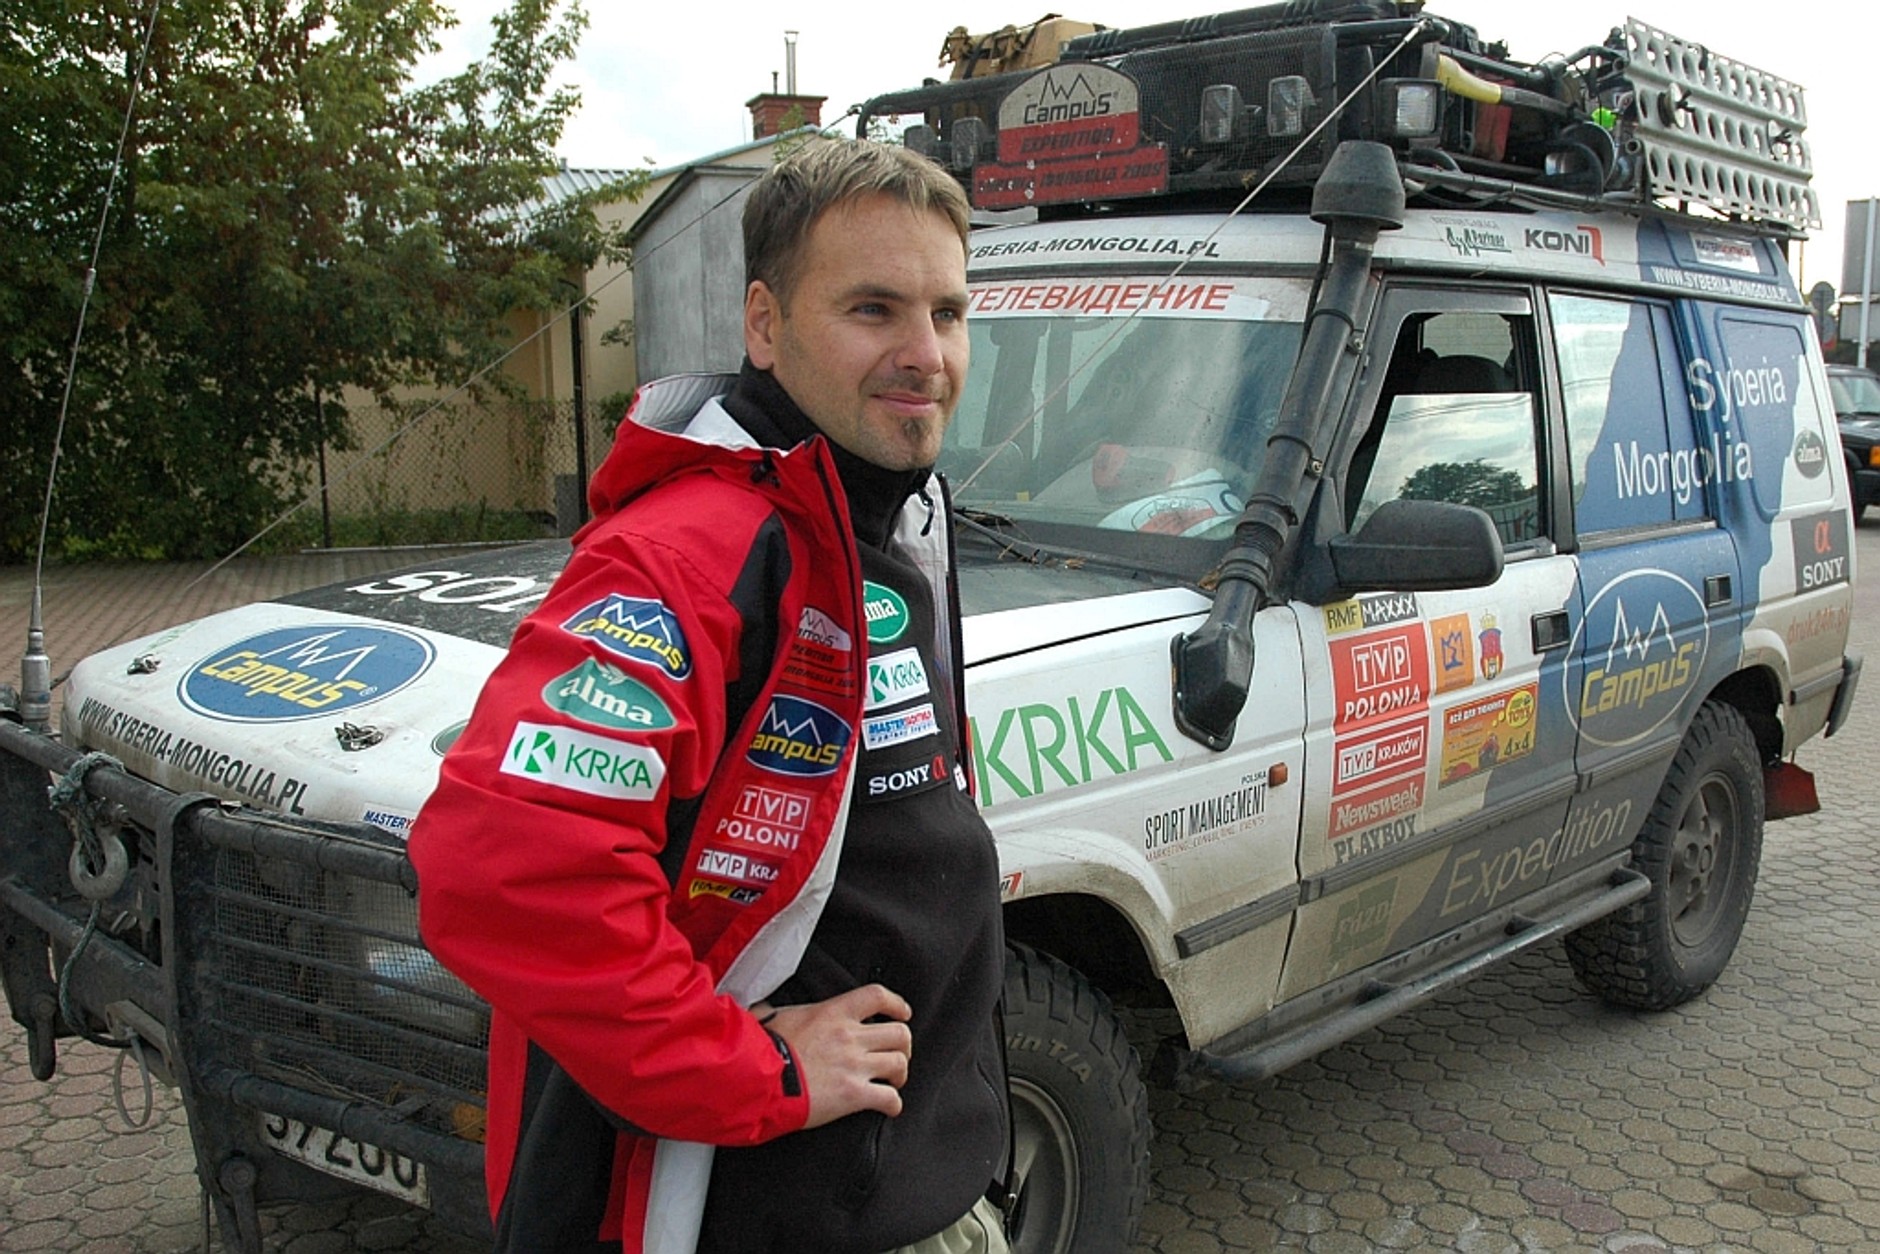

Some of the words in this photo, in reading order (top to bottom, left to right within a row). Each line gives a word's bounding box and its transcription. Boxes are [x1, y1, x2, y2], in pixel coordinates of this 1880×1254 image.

[1525, 228, 1591, 254] KONI
[1688, 357, 1788, 422] Syberia
[1614, 432, 1753, 504] Mongolia
[1803, 557, 1844, 588] SONY
[1327, 604, 1357, 630] RMF
[1362, 594, 1416, 623] MAXXX
[891, 660, 925, 691] KRKA
[1356, 645, 1407, 683] TVP
[559, 675, 654, 725] alma
[1344, 684, 1421, 722] POLONIA
[79, 697, 309, 816] WWW.SYBERIA-MONGOLIA.PL
[565, 744, 652, 789] KRKA
[970, 687, 1174, 807] KRKA
[1343, 748, 1374, 777] TVP
[1378, 735, 1422, 762] KRAKÓW
[869, 764, 931, 795] SONY
[742, 791, 802, 822] TVP
[1145, 807, 1186, 849] SPORT
[1187, 783, 1268, 836] MANAGEMENT
[1335, 782, 1419, 832] Newsweek
[1333, 814, 1417, 864] PLAYBOY
[1440, 798, 1632, 918] Expedition
[699, 853, 743, 873] TVP
